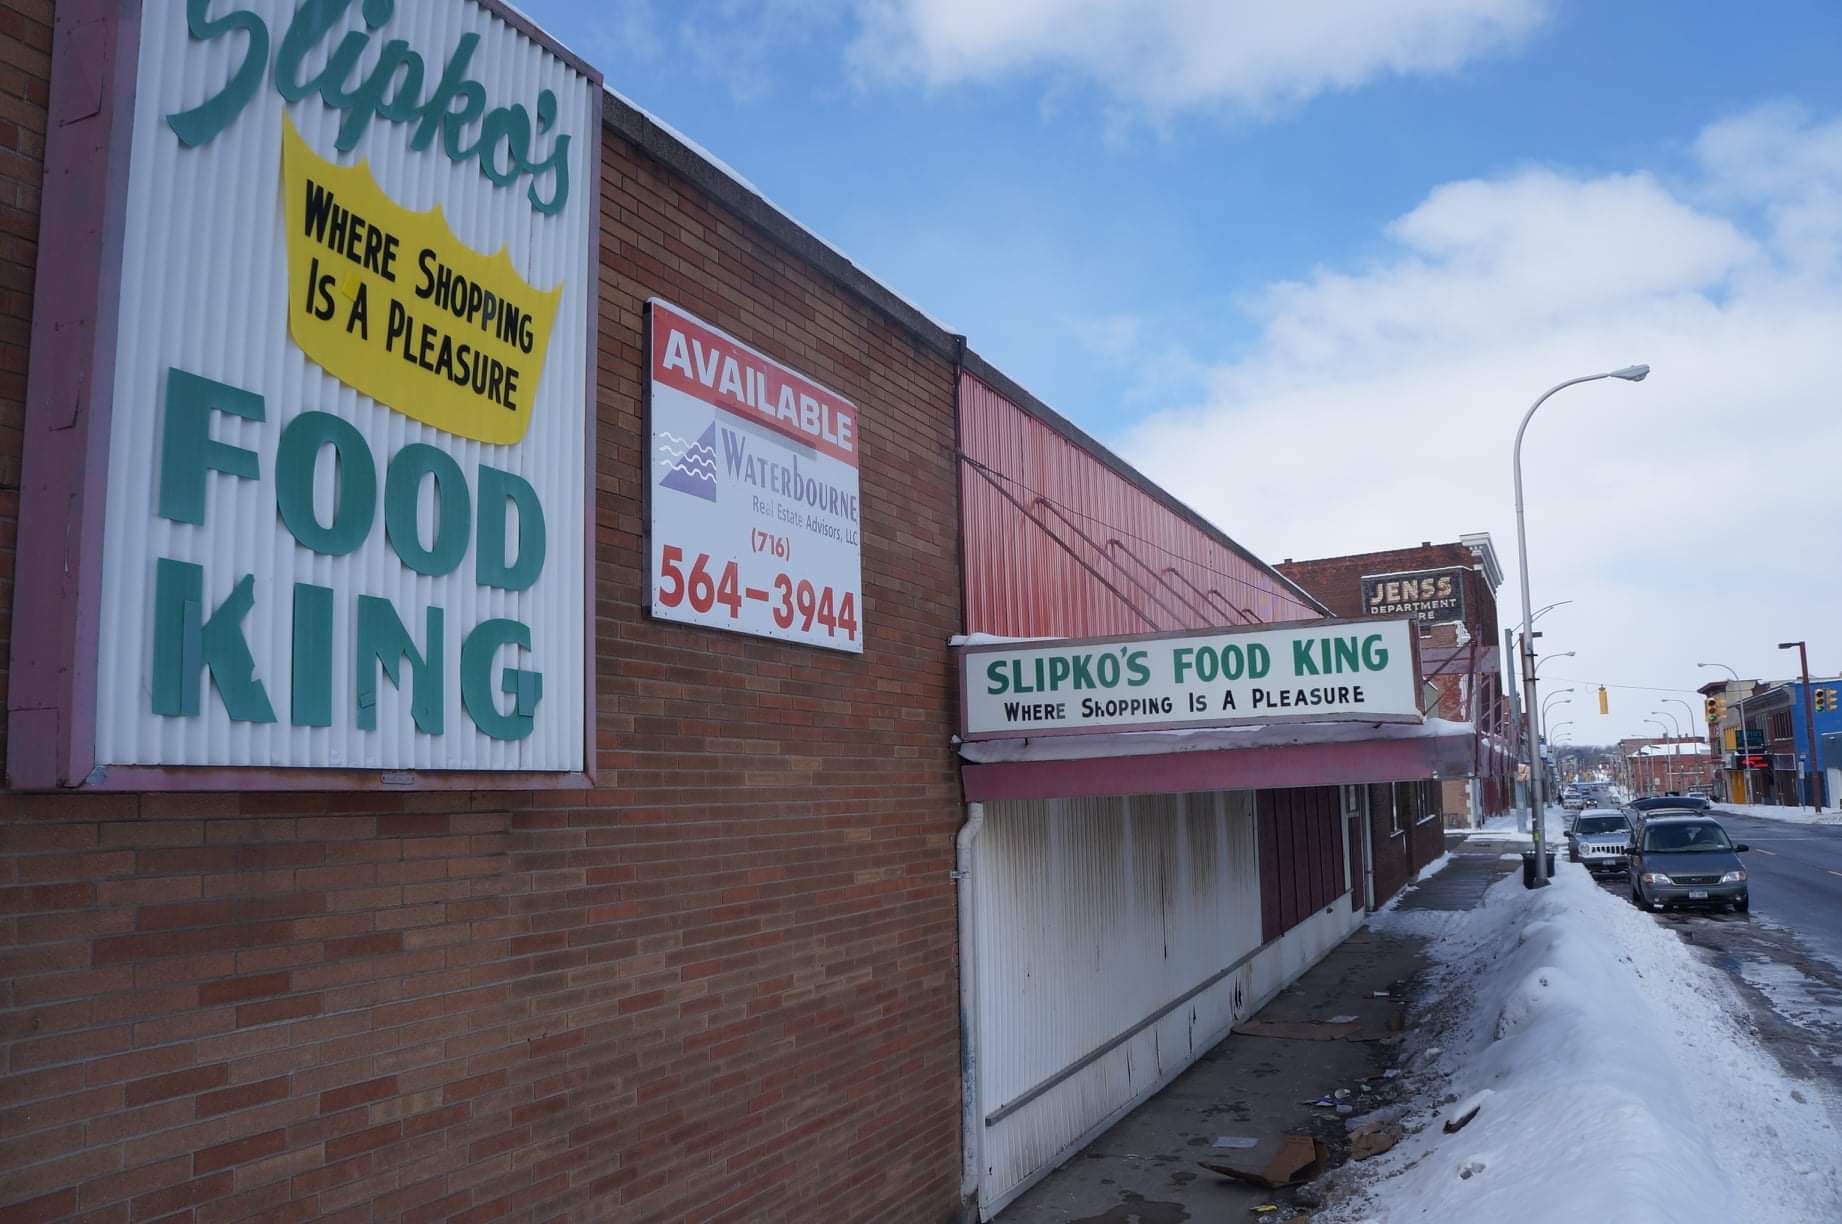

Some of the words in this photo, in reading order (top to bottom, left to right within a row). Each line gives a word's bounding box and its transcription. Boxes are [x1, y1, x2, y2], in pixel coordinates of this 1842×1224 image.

[167, 0, 571, 215] Slipko's
[304, 178, 399, 282] WHERE
[415, 248, 534, 354] SHOPPING
[306, 257, 336, 321] IS
[346, 281, 368, 341] A
[386, 298, 519, 411] PLEASURE
[662, 328, 853, 452] AVAILABLE
[159, 367, 546, 591] FOOD
[752, 495, 774, 518] Real
[777, 503, 802, 528] Estate
[806, 514, 843, 544] Advisors,
[845, 527, 858, 546] LLC
[658, 544, 857, 641] 564-3944
[752, 527, 790, 562] (716)
[1369, 576, 1452, 605] JENSS
[152, 558, 543, 741] KING
[1370, 598, 1457, 614] DEPARTMENT
[987, 645, 1151, 696] SLIPKO'S
[1173, 643, 1271, 685] FOOD
[1292, 633, 1389, 677] KING
[1004, 702, 1066, 722] WHERE
[1082, 697, 1173, 718] SHOPPING
[1188, 692, 1208, 712] IS
[1222, 689, 1236, 711] A
[1252, 685, 1365, 709] PLEASURE
